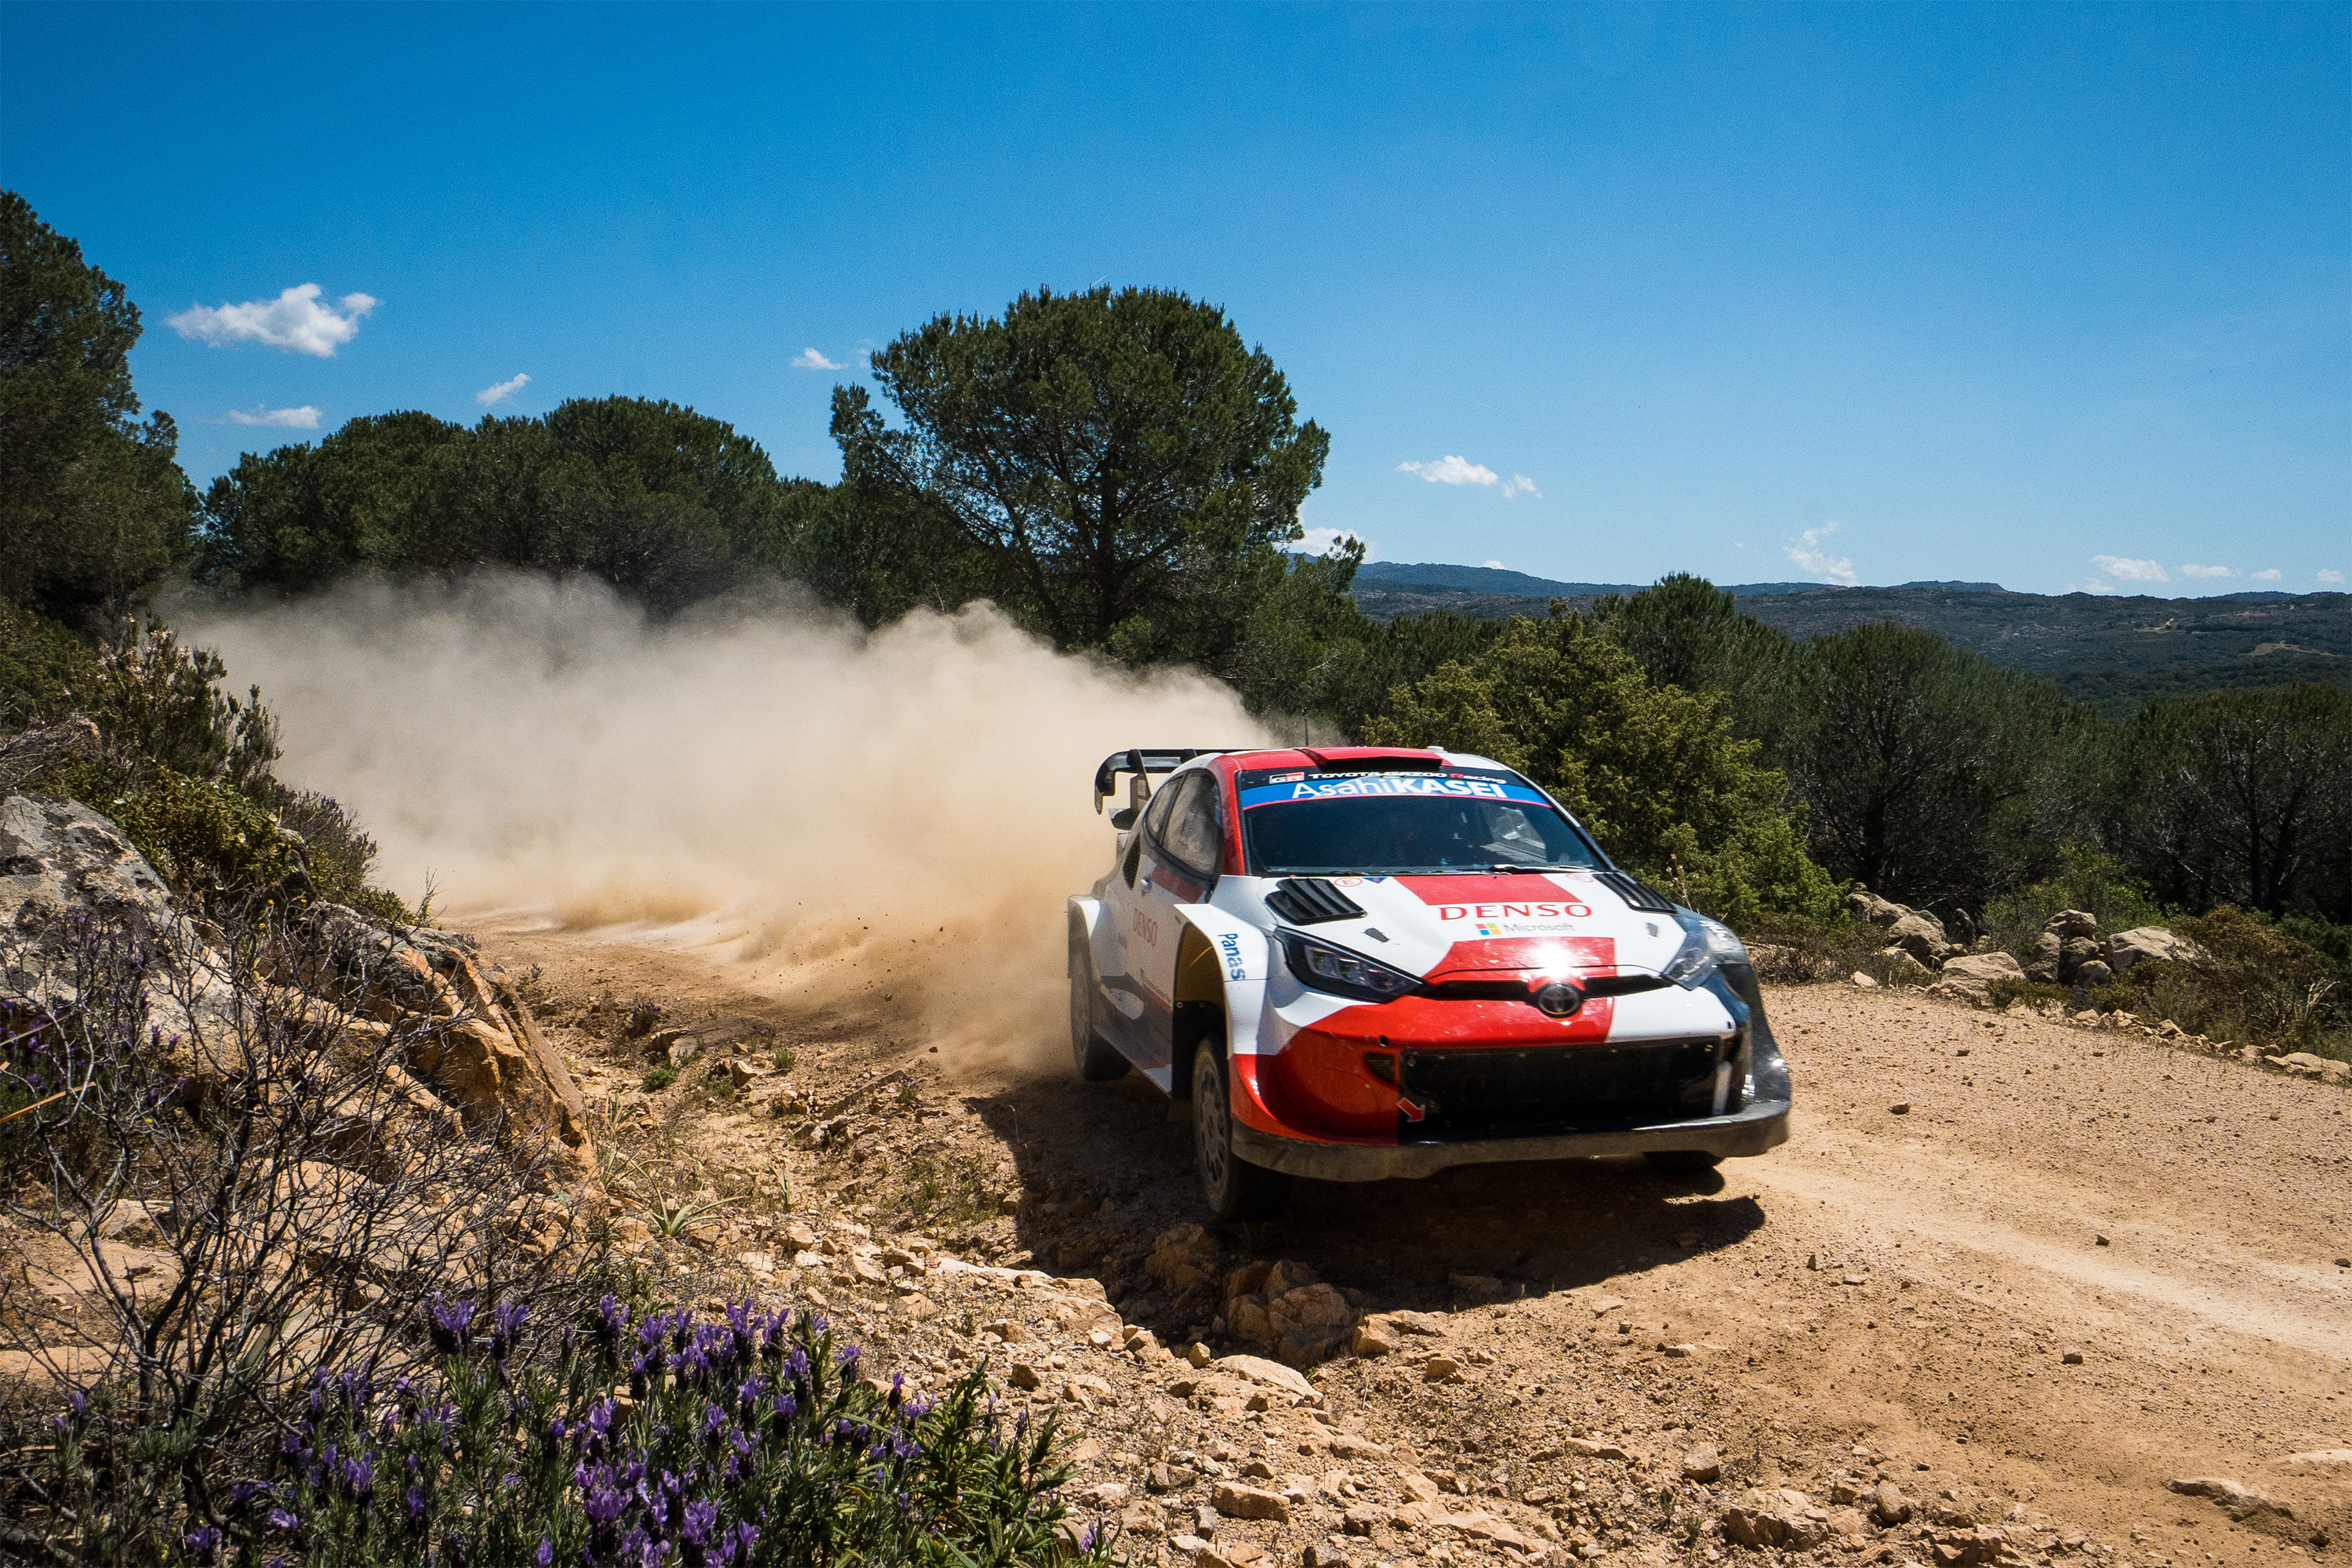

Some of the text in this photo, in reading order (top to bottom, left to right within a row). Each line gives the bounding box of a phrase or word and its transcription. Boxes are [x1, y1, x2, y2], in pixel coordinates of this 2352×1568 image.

[1270, 775, 1305, 783] GR
[1450, 773, 1506, 784] Racing
[1292, 779, 1508, 798] AsahiKASEI
[1439, 904, 1592, 920] DENSO
[1503, 923, 1576, 931] Microsoft
[1218, 933, 1245, 980] Panas
